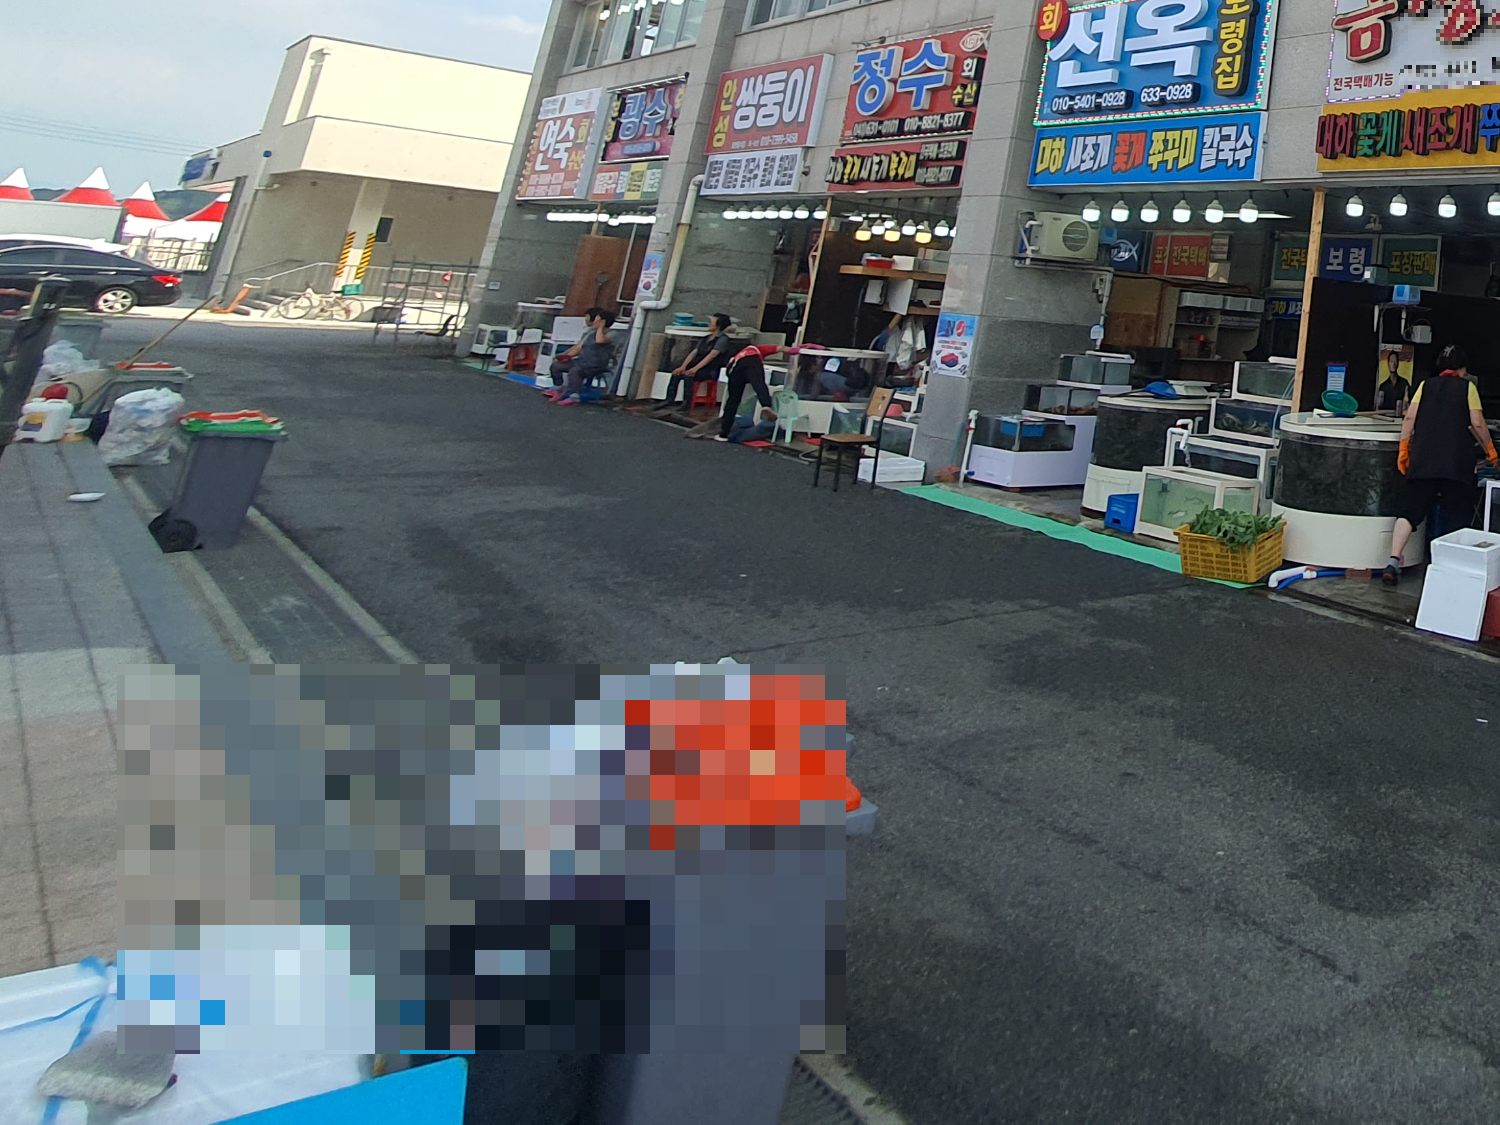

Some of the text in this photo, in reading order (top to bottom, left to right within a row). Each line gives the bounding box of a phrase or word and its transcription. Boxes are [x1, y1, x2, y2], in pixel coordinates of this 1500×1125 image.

[1041, 2, 1058, 32] 회
[852, 39, 950, 116] 정수
[961, 57, 977, 79] 회
[1333, 73, 1394, 91] 전국택배가능
[619, 88, 667, 140] 광수
[713, 79, 736, 148] 안성
[733, 65, 815, 130] 쌍둥이
[952, 82, 976, 108] 수산
[1052, 84, 1192, 112] 010-5401-0928 633-0928
[1200, 125, 1253, 171] 칼국수
[1316, 113, 1356, 159] 대하
[1357, 111, 1400, 157] 꽃게
[1402, 105, 1476, 155] 새조개
[1326, 247, 1366, 275] 보령
